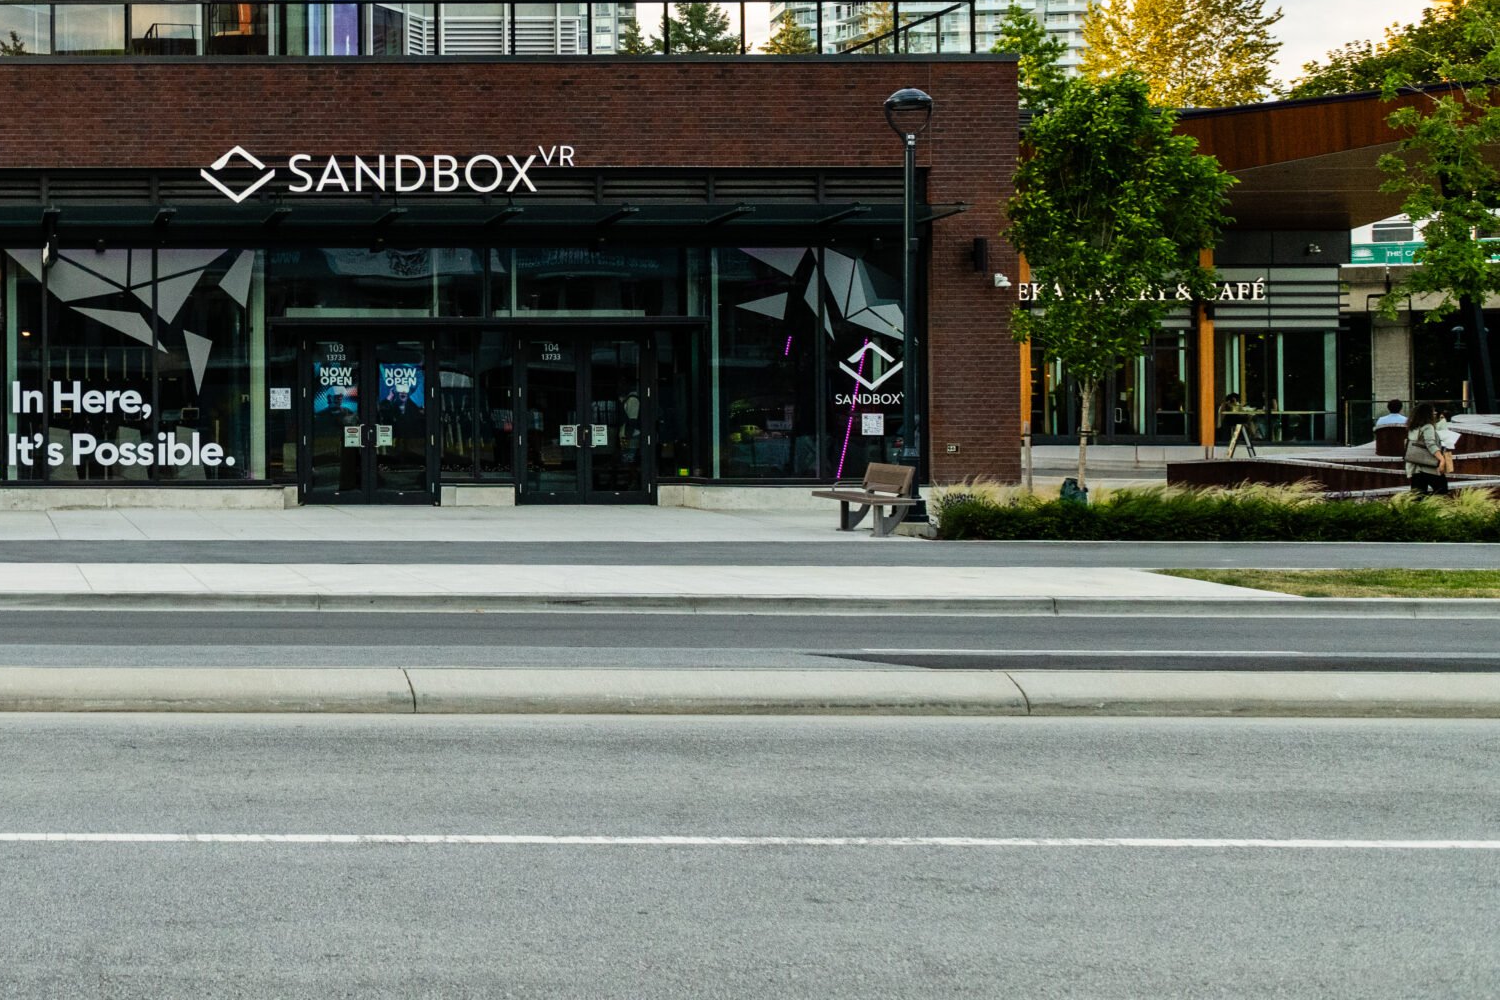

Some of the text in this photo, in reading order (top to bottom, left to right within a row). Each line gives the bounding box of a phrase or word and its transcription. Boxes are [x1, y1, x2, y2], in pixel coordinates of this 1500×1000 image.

[288, 154, 537, 193] SANDBOX
[329, 344, 345, 353] 103
[544, 343, 560, 352] 104
[541, 353, 561, 361] 13733
[320, 367, 352, 377] NOW
[384, 368, 417, 378] NOW
[320, 376, 353, 386] OPEN
[385, 377, 417, 387] OPEN
[12, 380, 152, 419] In Here,
[835, 393, 901, 405] SANDBOX
[8, 432, 236, 466] It's Possible.
